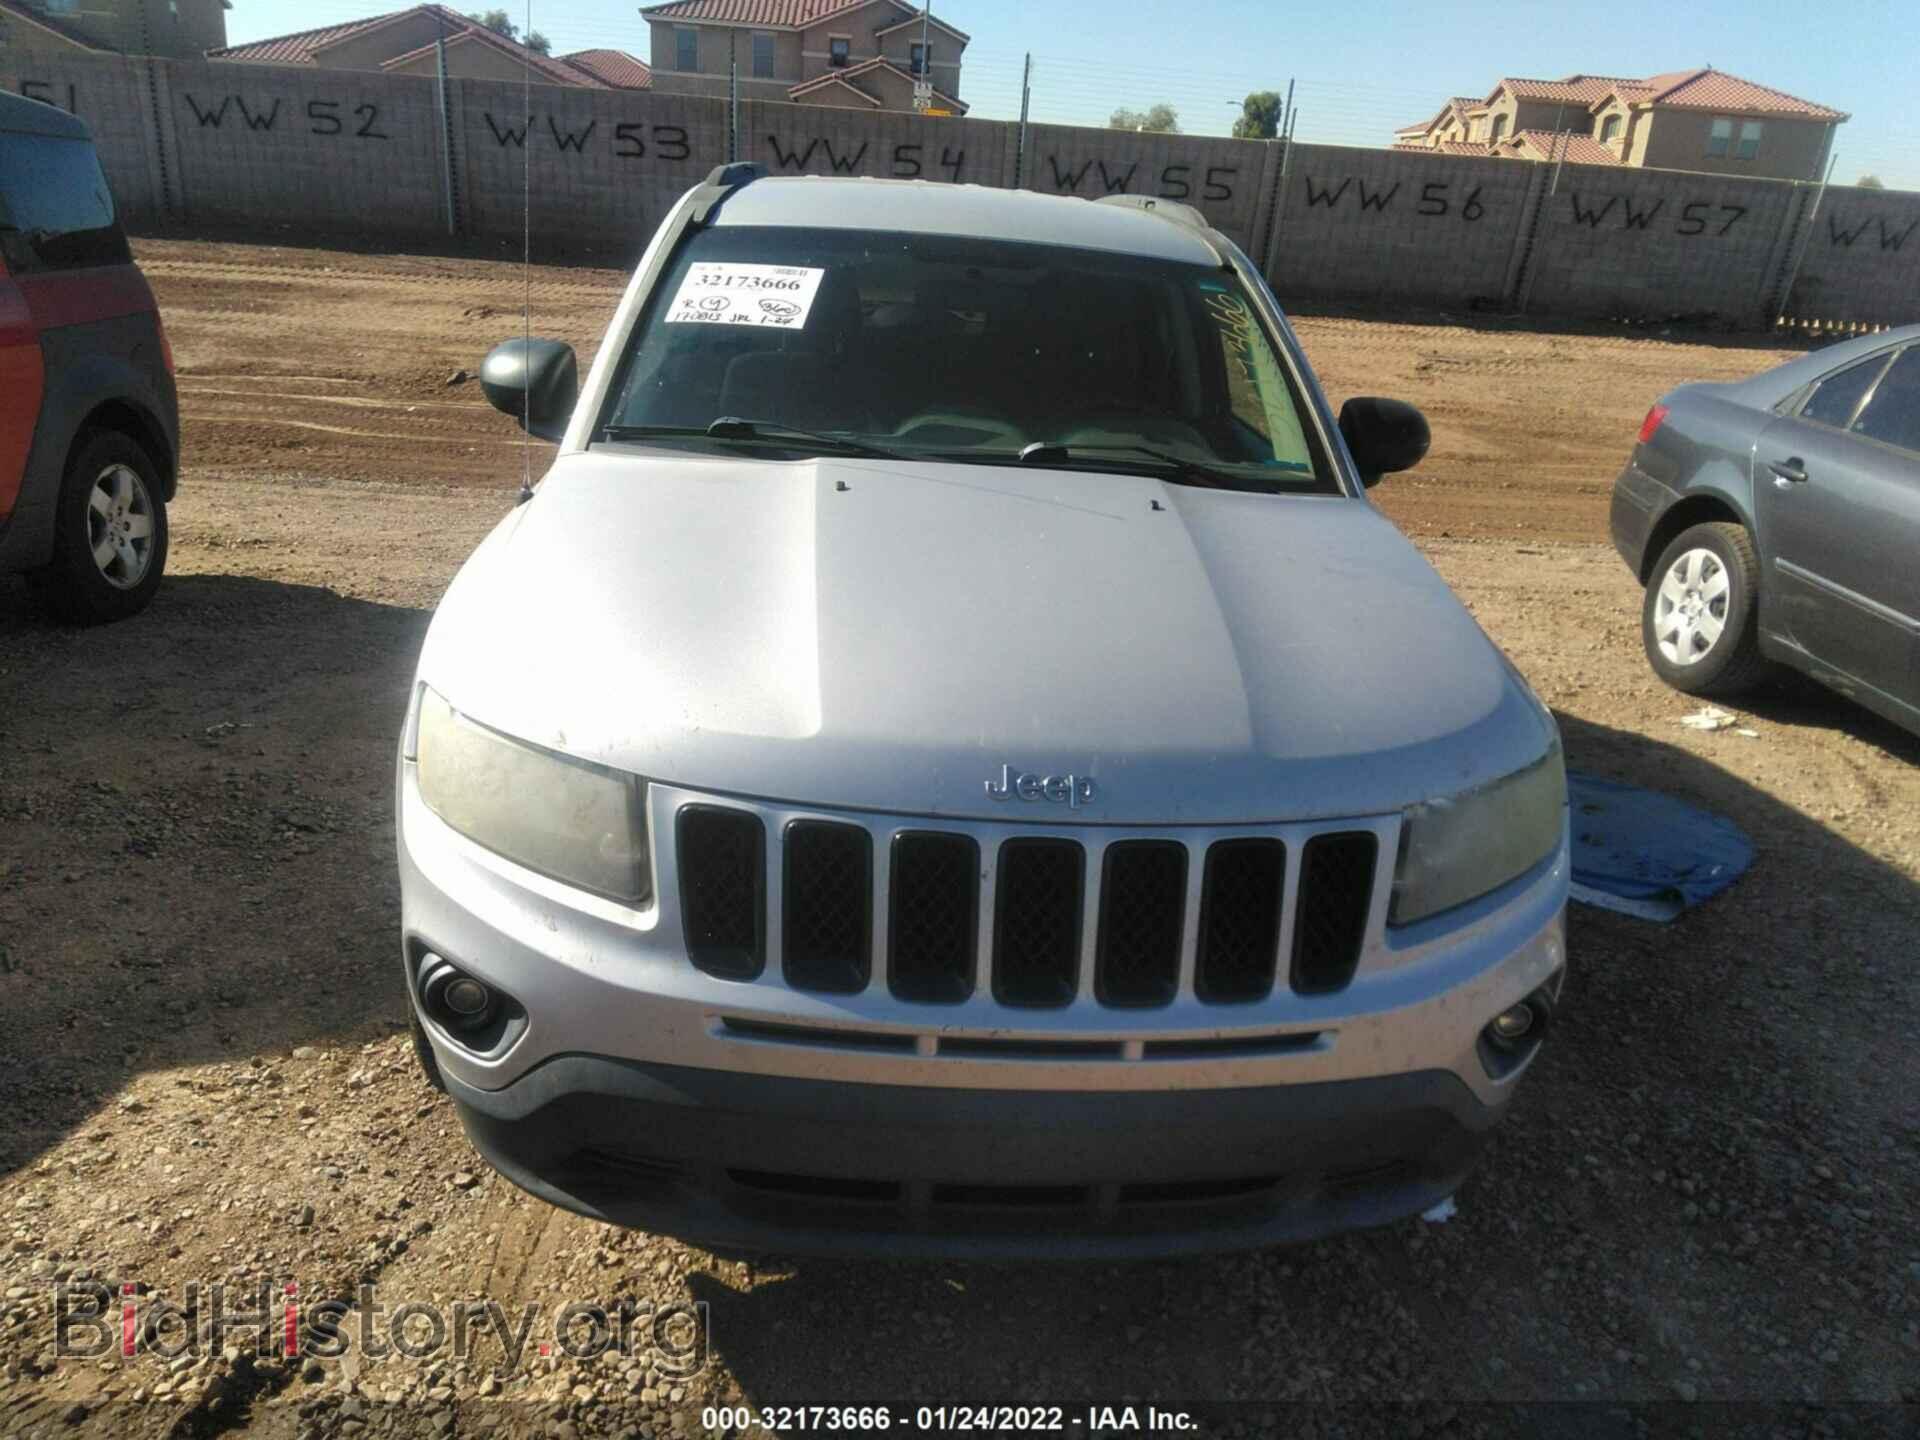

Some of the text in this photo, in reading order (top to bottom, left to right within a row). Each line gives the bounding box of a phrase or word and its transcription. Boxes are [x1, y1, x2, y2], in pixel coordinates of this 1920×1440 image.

[186, 93, 389, 140] WW 52
[484, 112, 691, 160] WW 53
[767, 135, 965, 182] WW 54
[1049, 154, 1240, 201] WW 55
[1304, 174, 1486, 222] WW 56
[1570, 194, 1749, 237] WW 57
[1826, 213, 1919, 252] WW
[694, 273, 801, 291] 32173666
[983, 763, 1097, 810] Jeep
